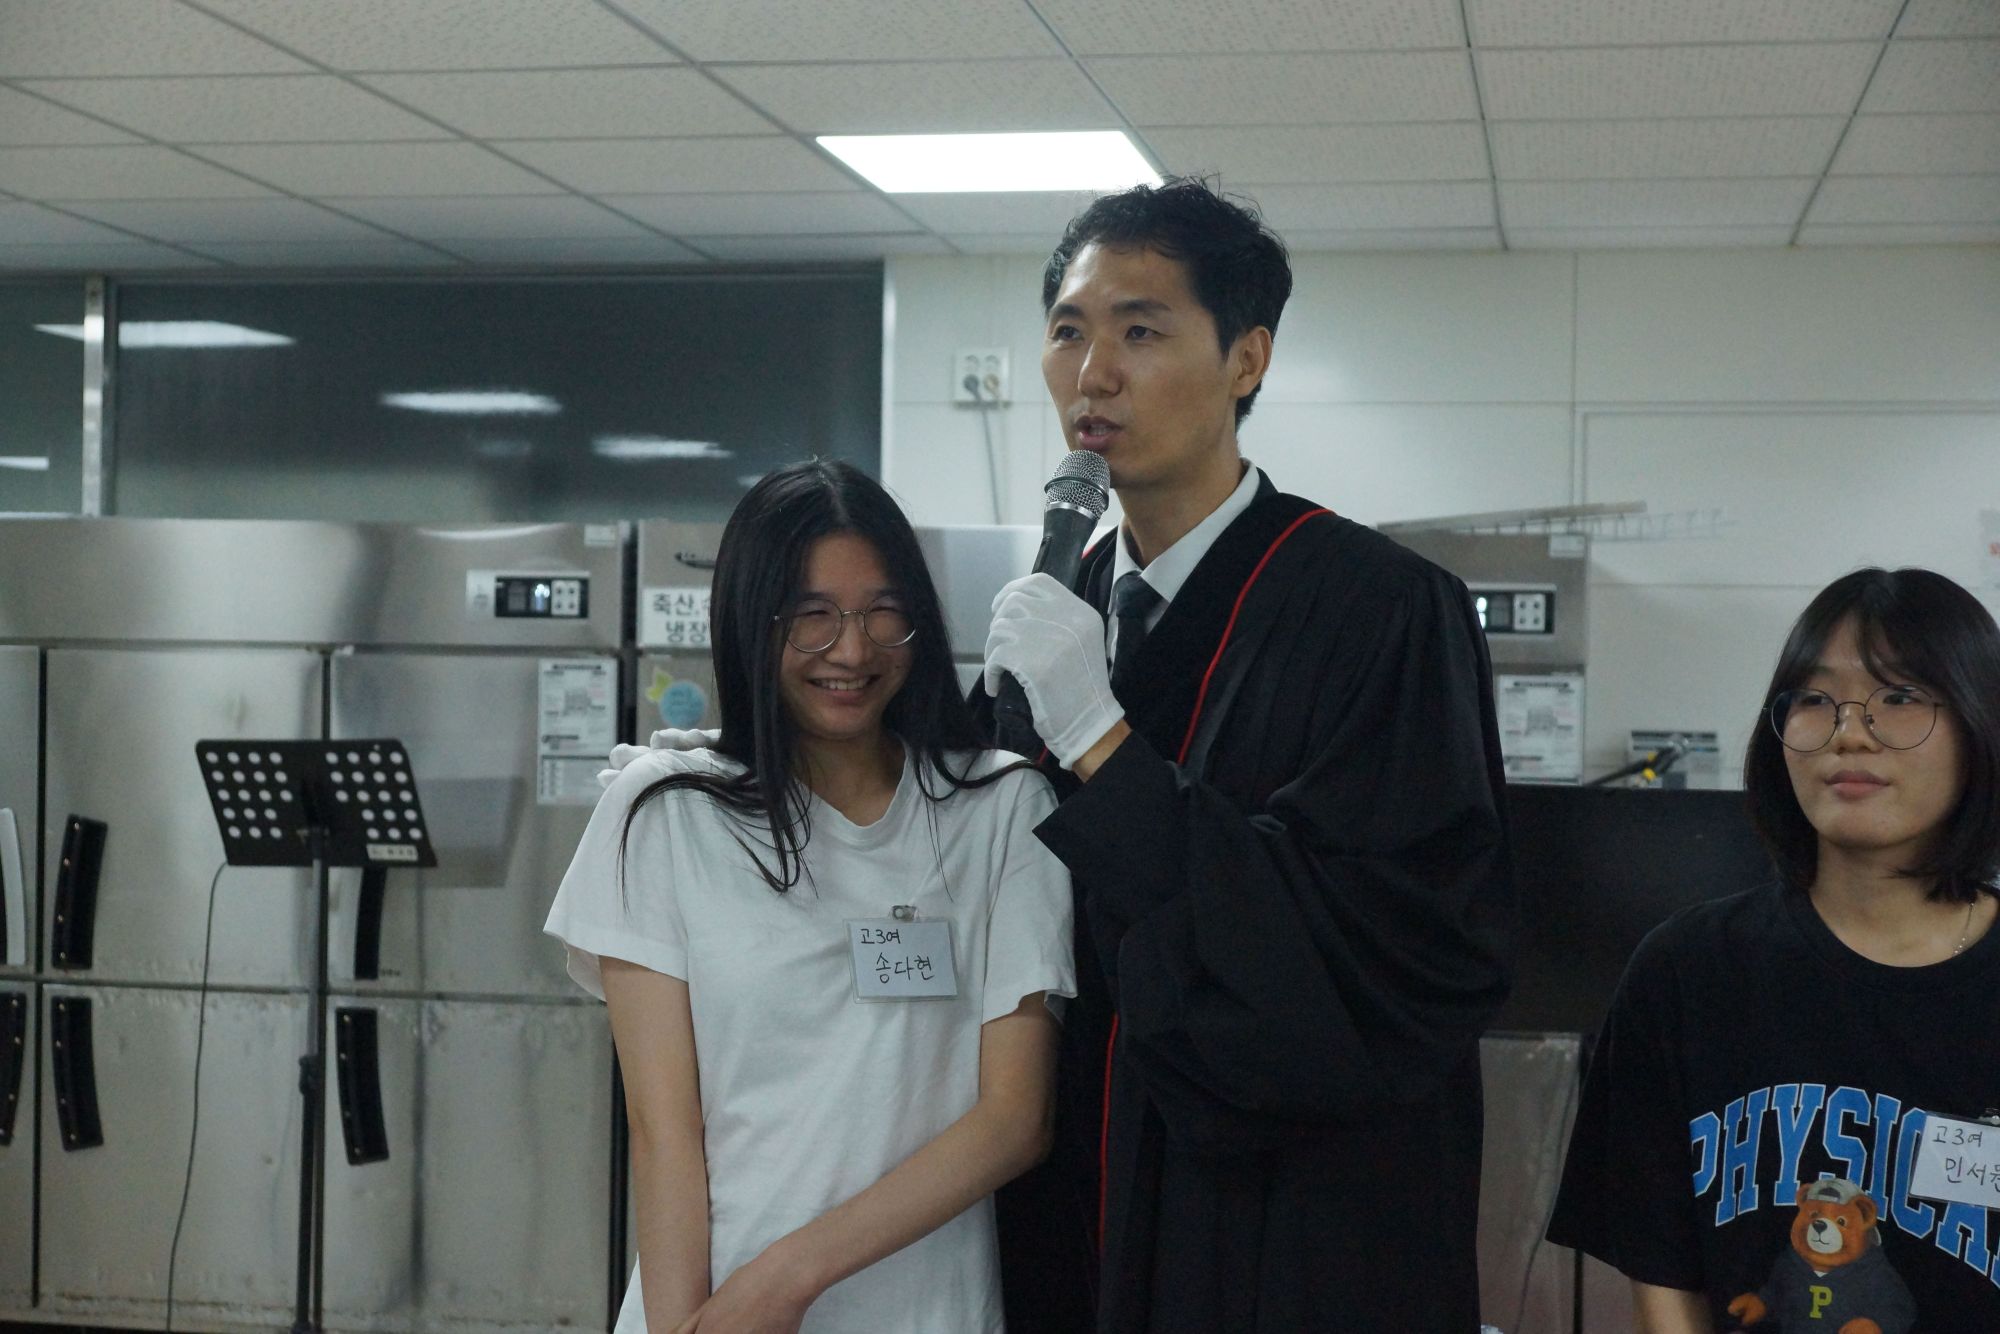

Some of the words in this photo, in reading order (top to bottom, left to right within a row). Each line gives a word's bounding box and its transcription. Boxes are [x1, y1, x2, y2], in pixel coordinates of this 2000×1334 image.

[860, 928, 901, 944] 고3여
[875, 952, 935, 983] 송다현
[1932, 1125, 1983, 1148] 고3여
[1689, 1083, 2000, 1290] PHYSICA
[1808, 1285, 1833, 1319] P
